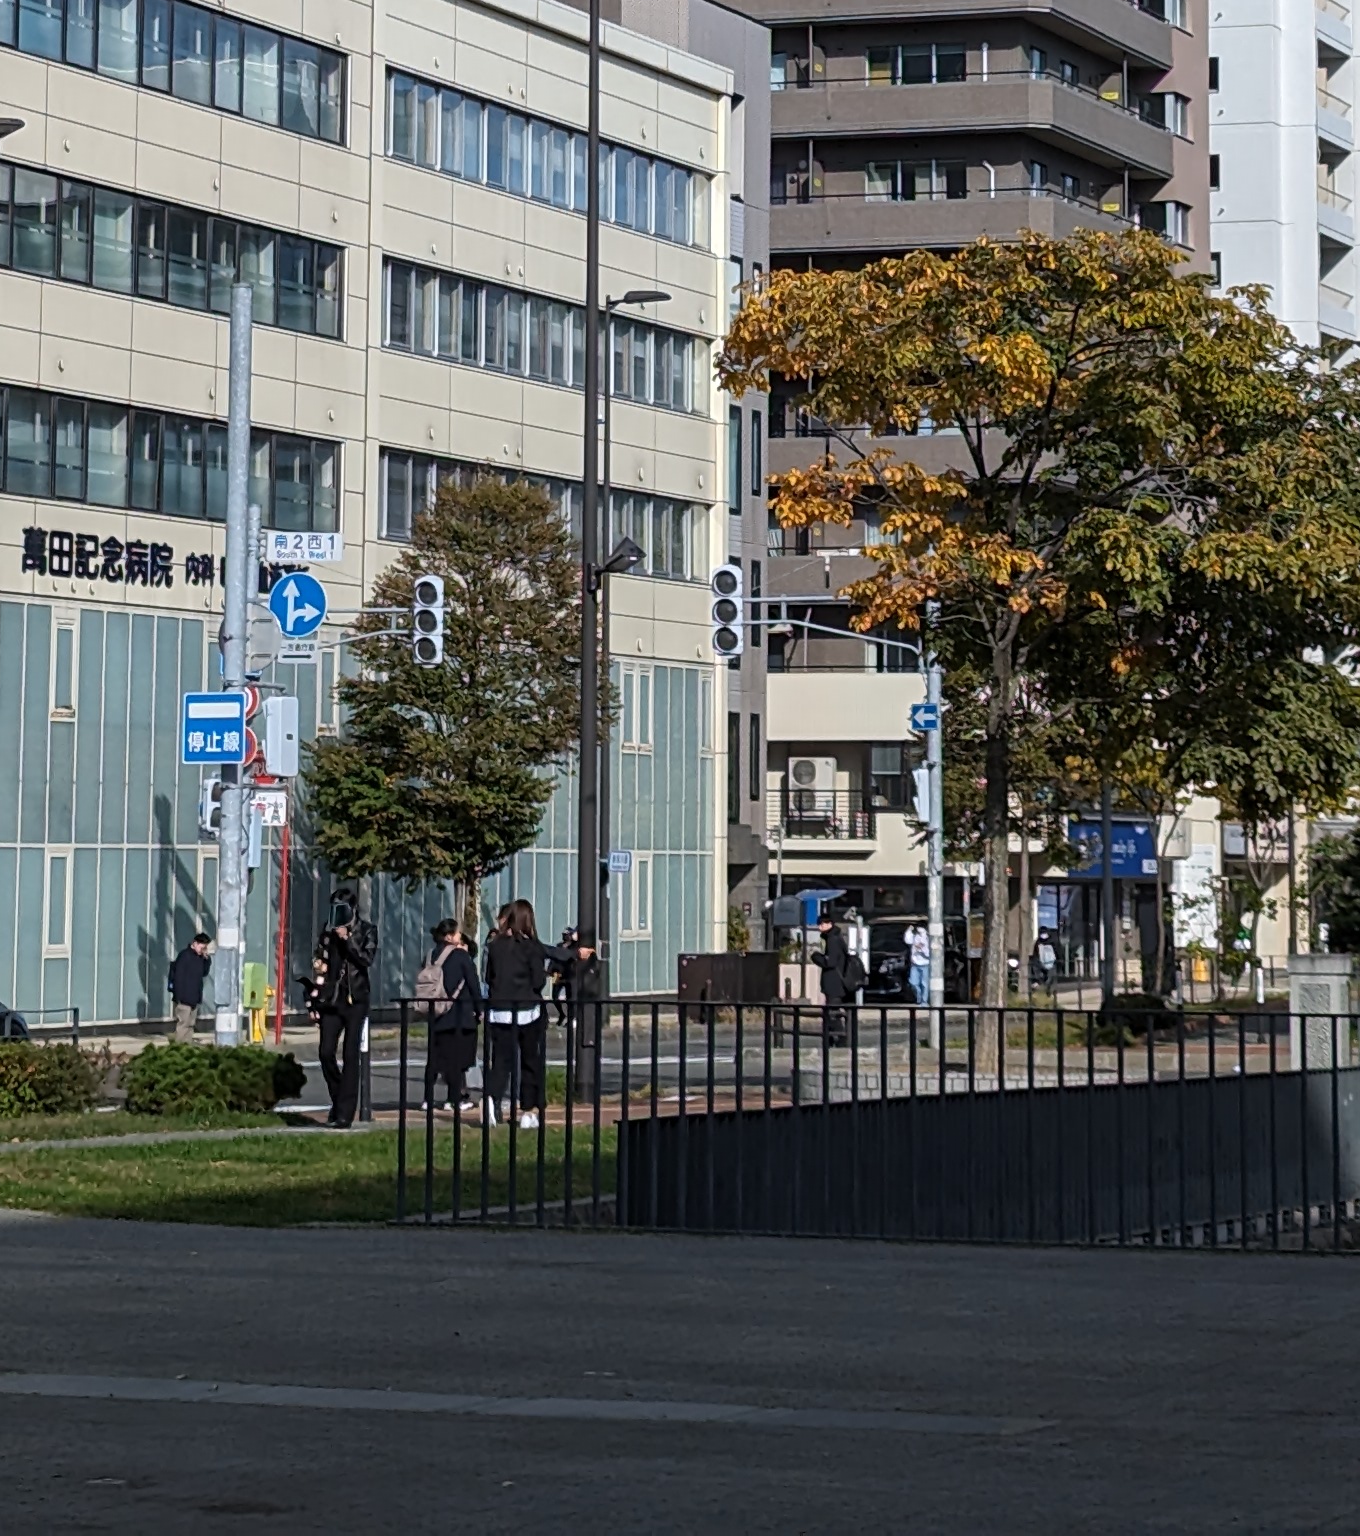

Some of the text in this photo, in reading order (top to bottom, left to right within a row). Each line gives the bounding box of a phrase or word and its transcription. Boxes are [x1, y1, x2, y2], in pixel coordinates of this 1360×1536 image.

[22, 526, 173, 589] 萬田記念病院
[187, 730, 240, 753] 停止線
